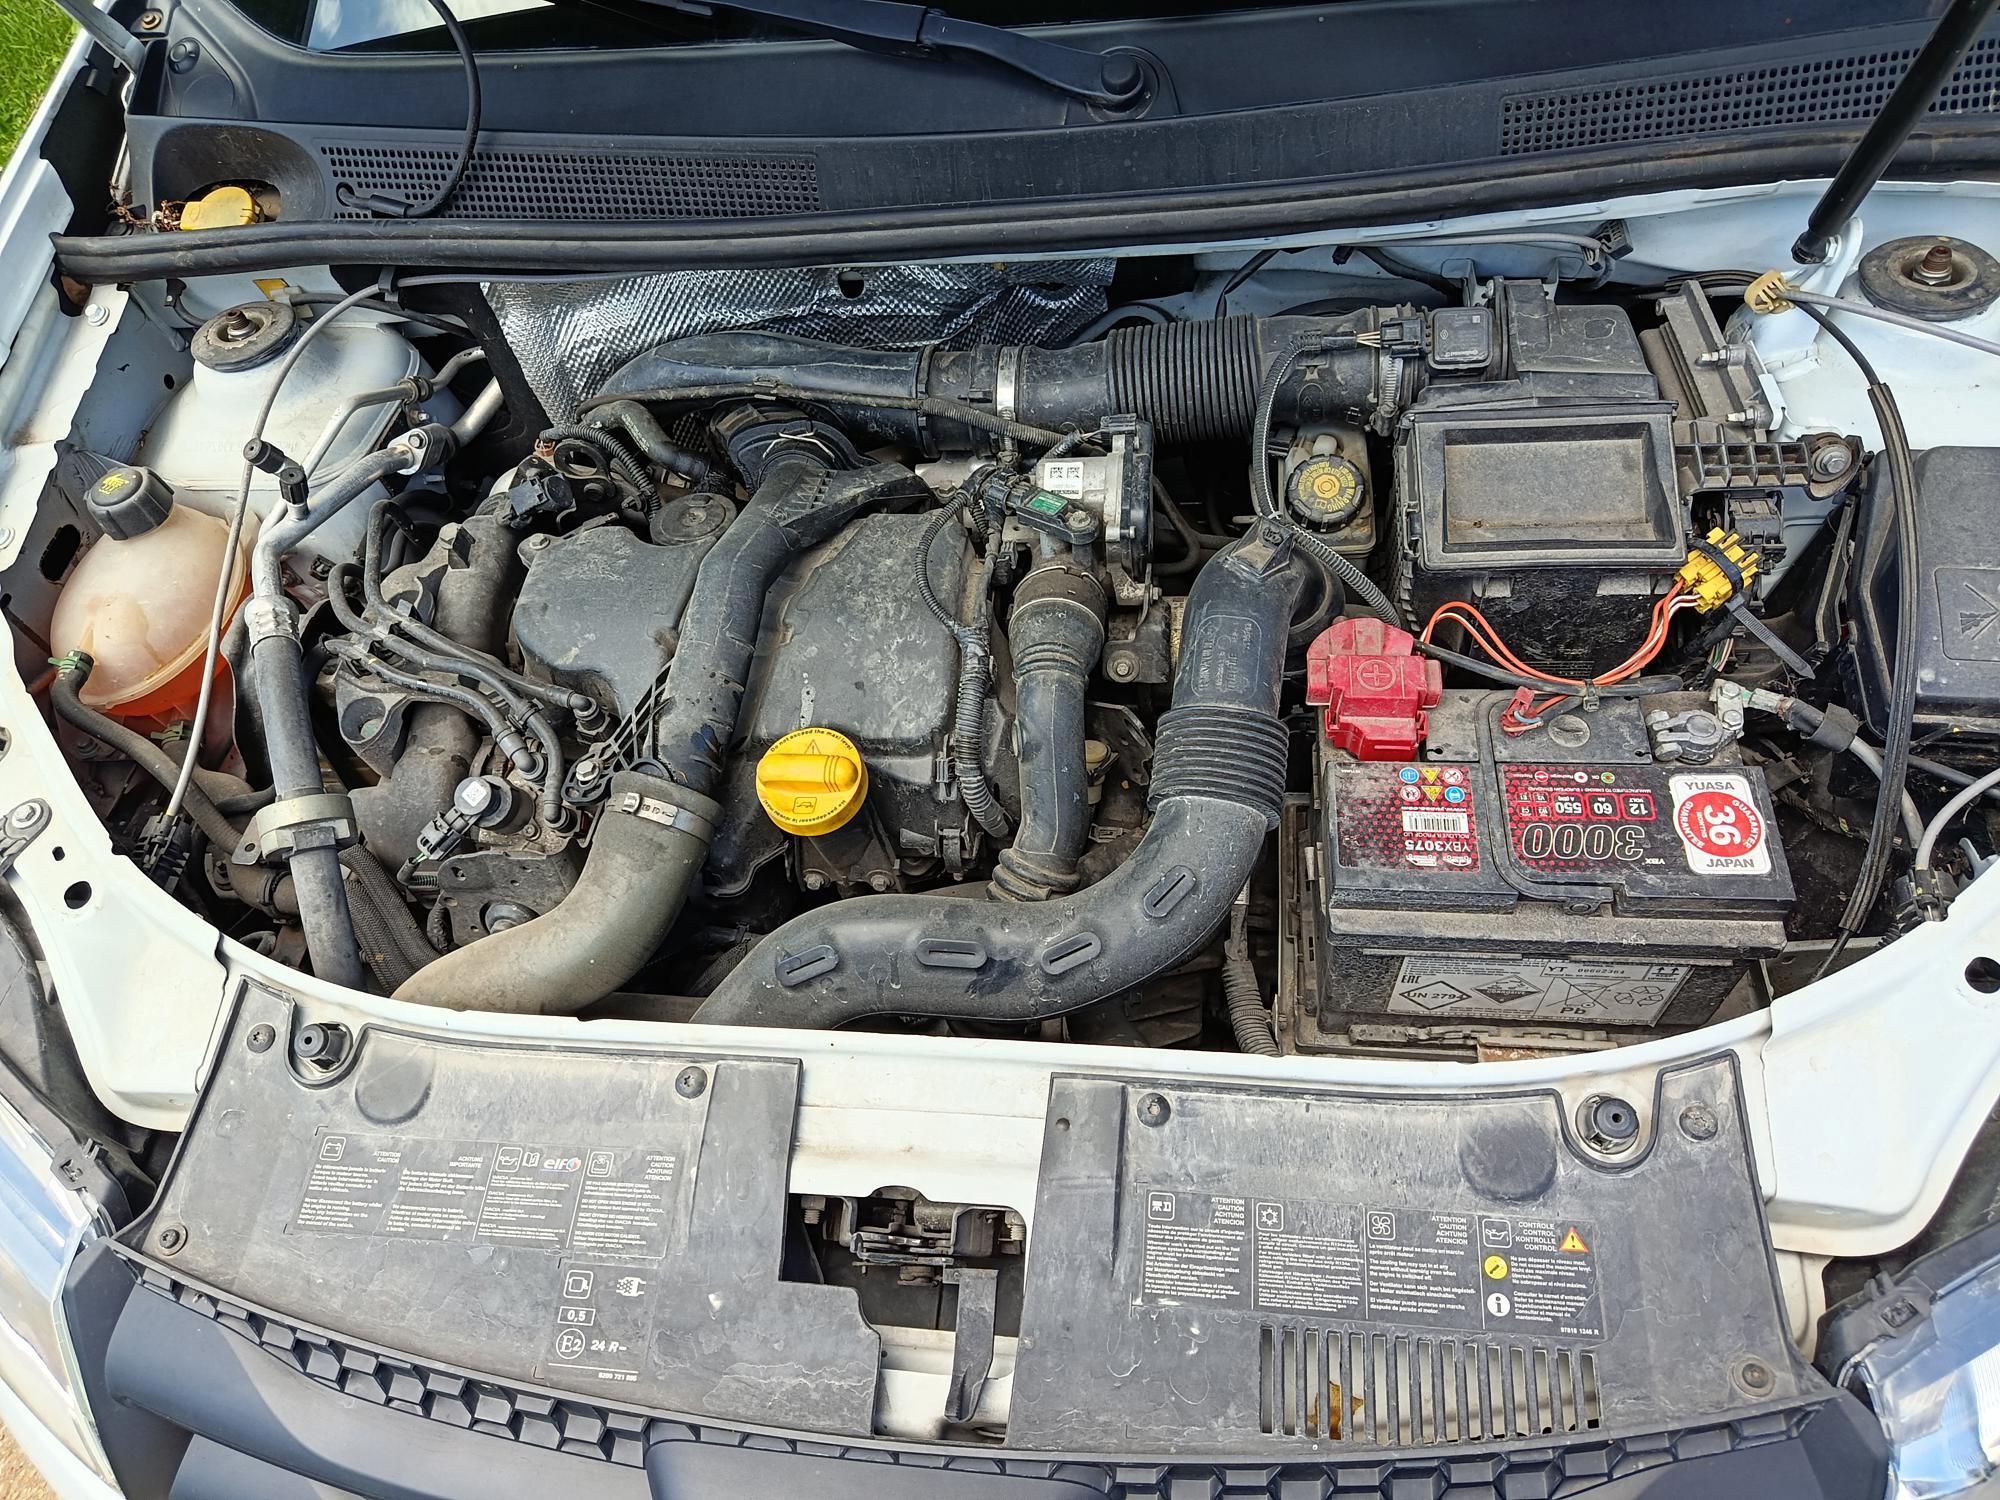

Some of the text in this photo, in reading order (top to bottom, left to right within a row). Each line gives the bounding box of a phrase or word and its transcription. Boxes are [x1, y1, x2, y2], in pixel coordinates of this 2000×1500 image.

[779, 737, 789, 745] not
[790, 730, 812, 739] exceed
[826, 731, 840, 740] maxi
[841, 738, 853, 750] level
[1685, 782, 1735, 790] YUASA
[1555, 801, 1582, 814] 550
[1594, 802, 1613, 814] 60
[1629, 803, 1648, 815] 12
[1680, 801, 1705, 848] GUARANTEE
[1696, 812, 1708, 838] MONTHS
[1704, 805, 1741, 845] 36
[1732, 800, 1759, 848] GUARANTEE
[1405, 840, 1471, 852] YBX3075
[1522, 823, 1645, 860] 3000
[1706, 859, 1754, 867] JAPAN
[544, 1158, 568, 1169] elf
[1516, 1236, 1556, 1244] KONTROLLE
[567, 1310, 586, 1322] 0,5
[560, 1335, 581, 1352] E2
[591, 1340, 605, 1351] 24
